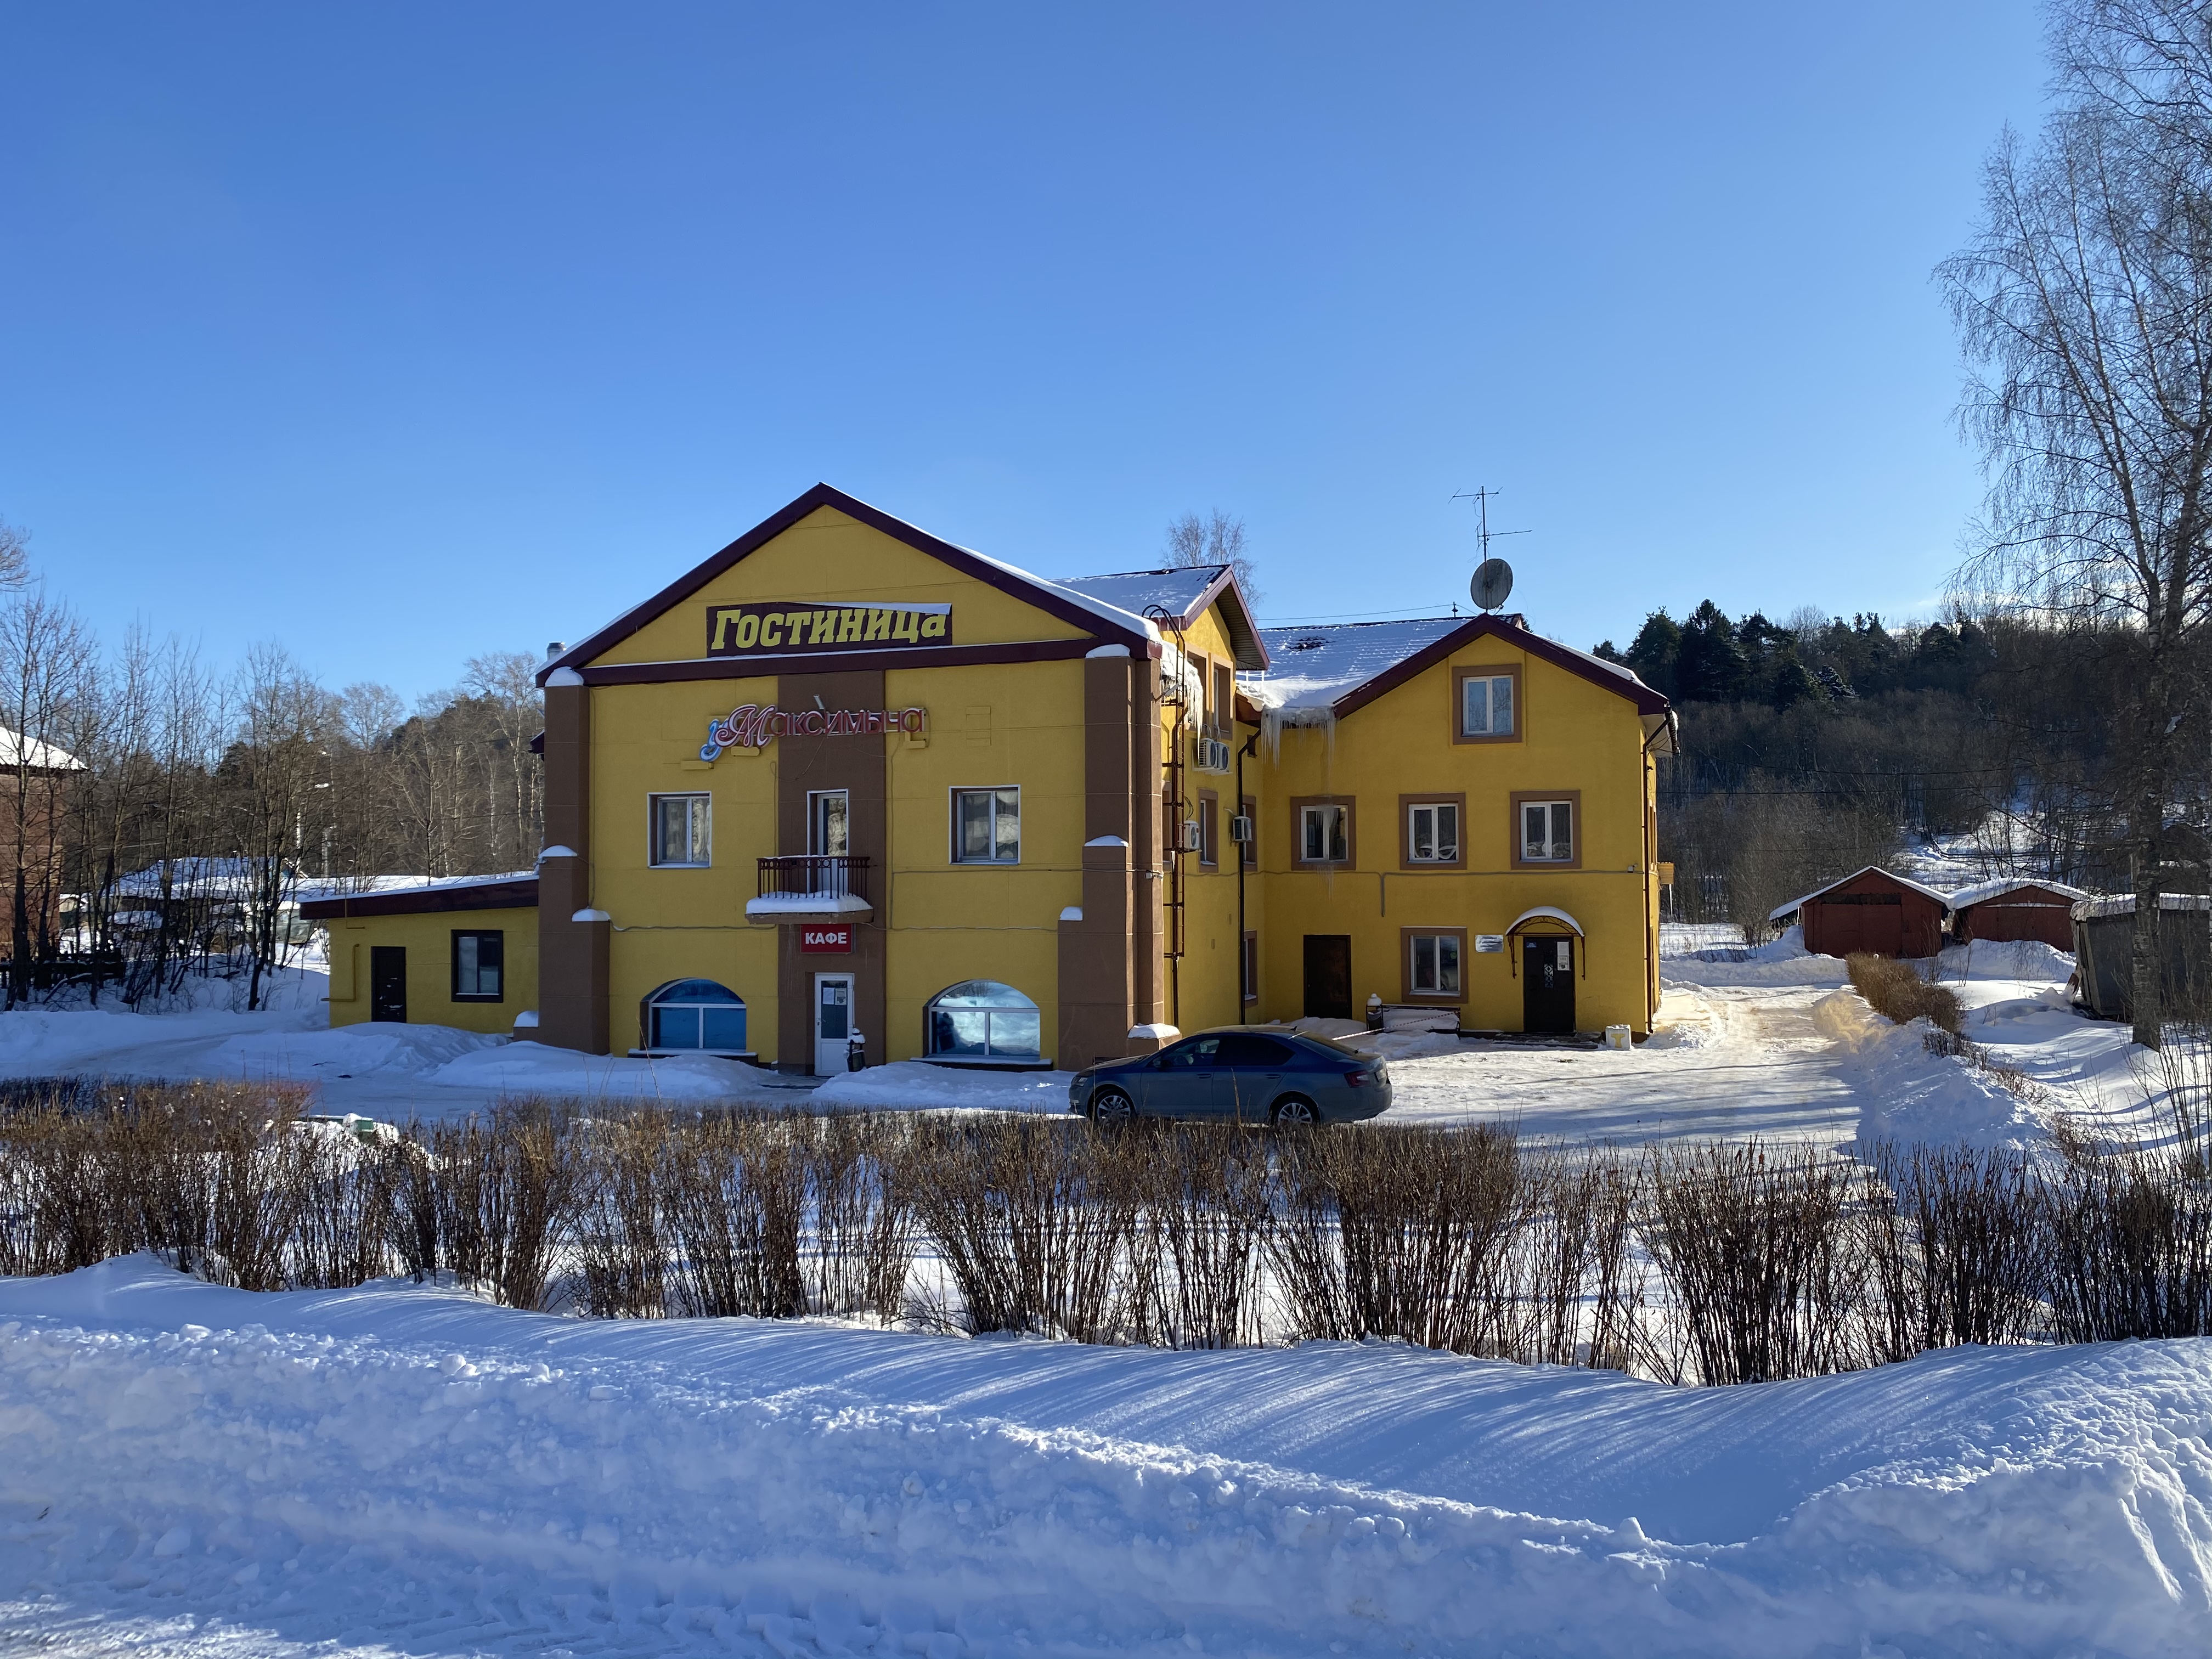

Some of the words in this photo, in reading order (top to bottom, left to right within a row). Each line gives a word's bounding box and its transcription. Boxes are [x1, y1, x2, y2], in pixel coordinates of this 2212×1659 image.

[711, 608, 946, 650] Гостиница
[714, 704, 924, 748] Максимыча
[805, 932, 847, 944] КАФЕ
